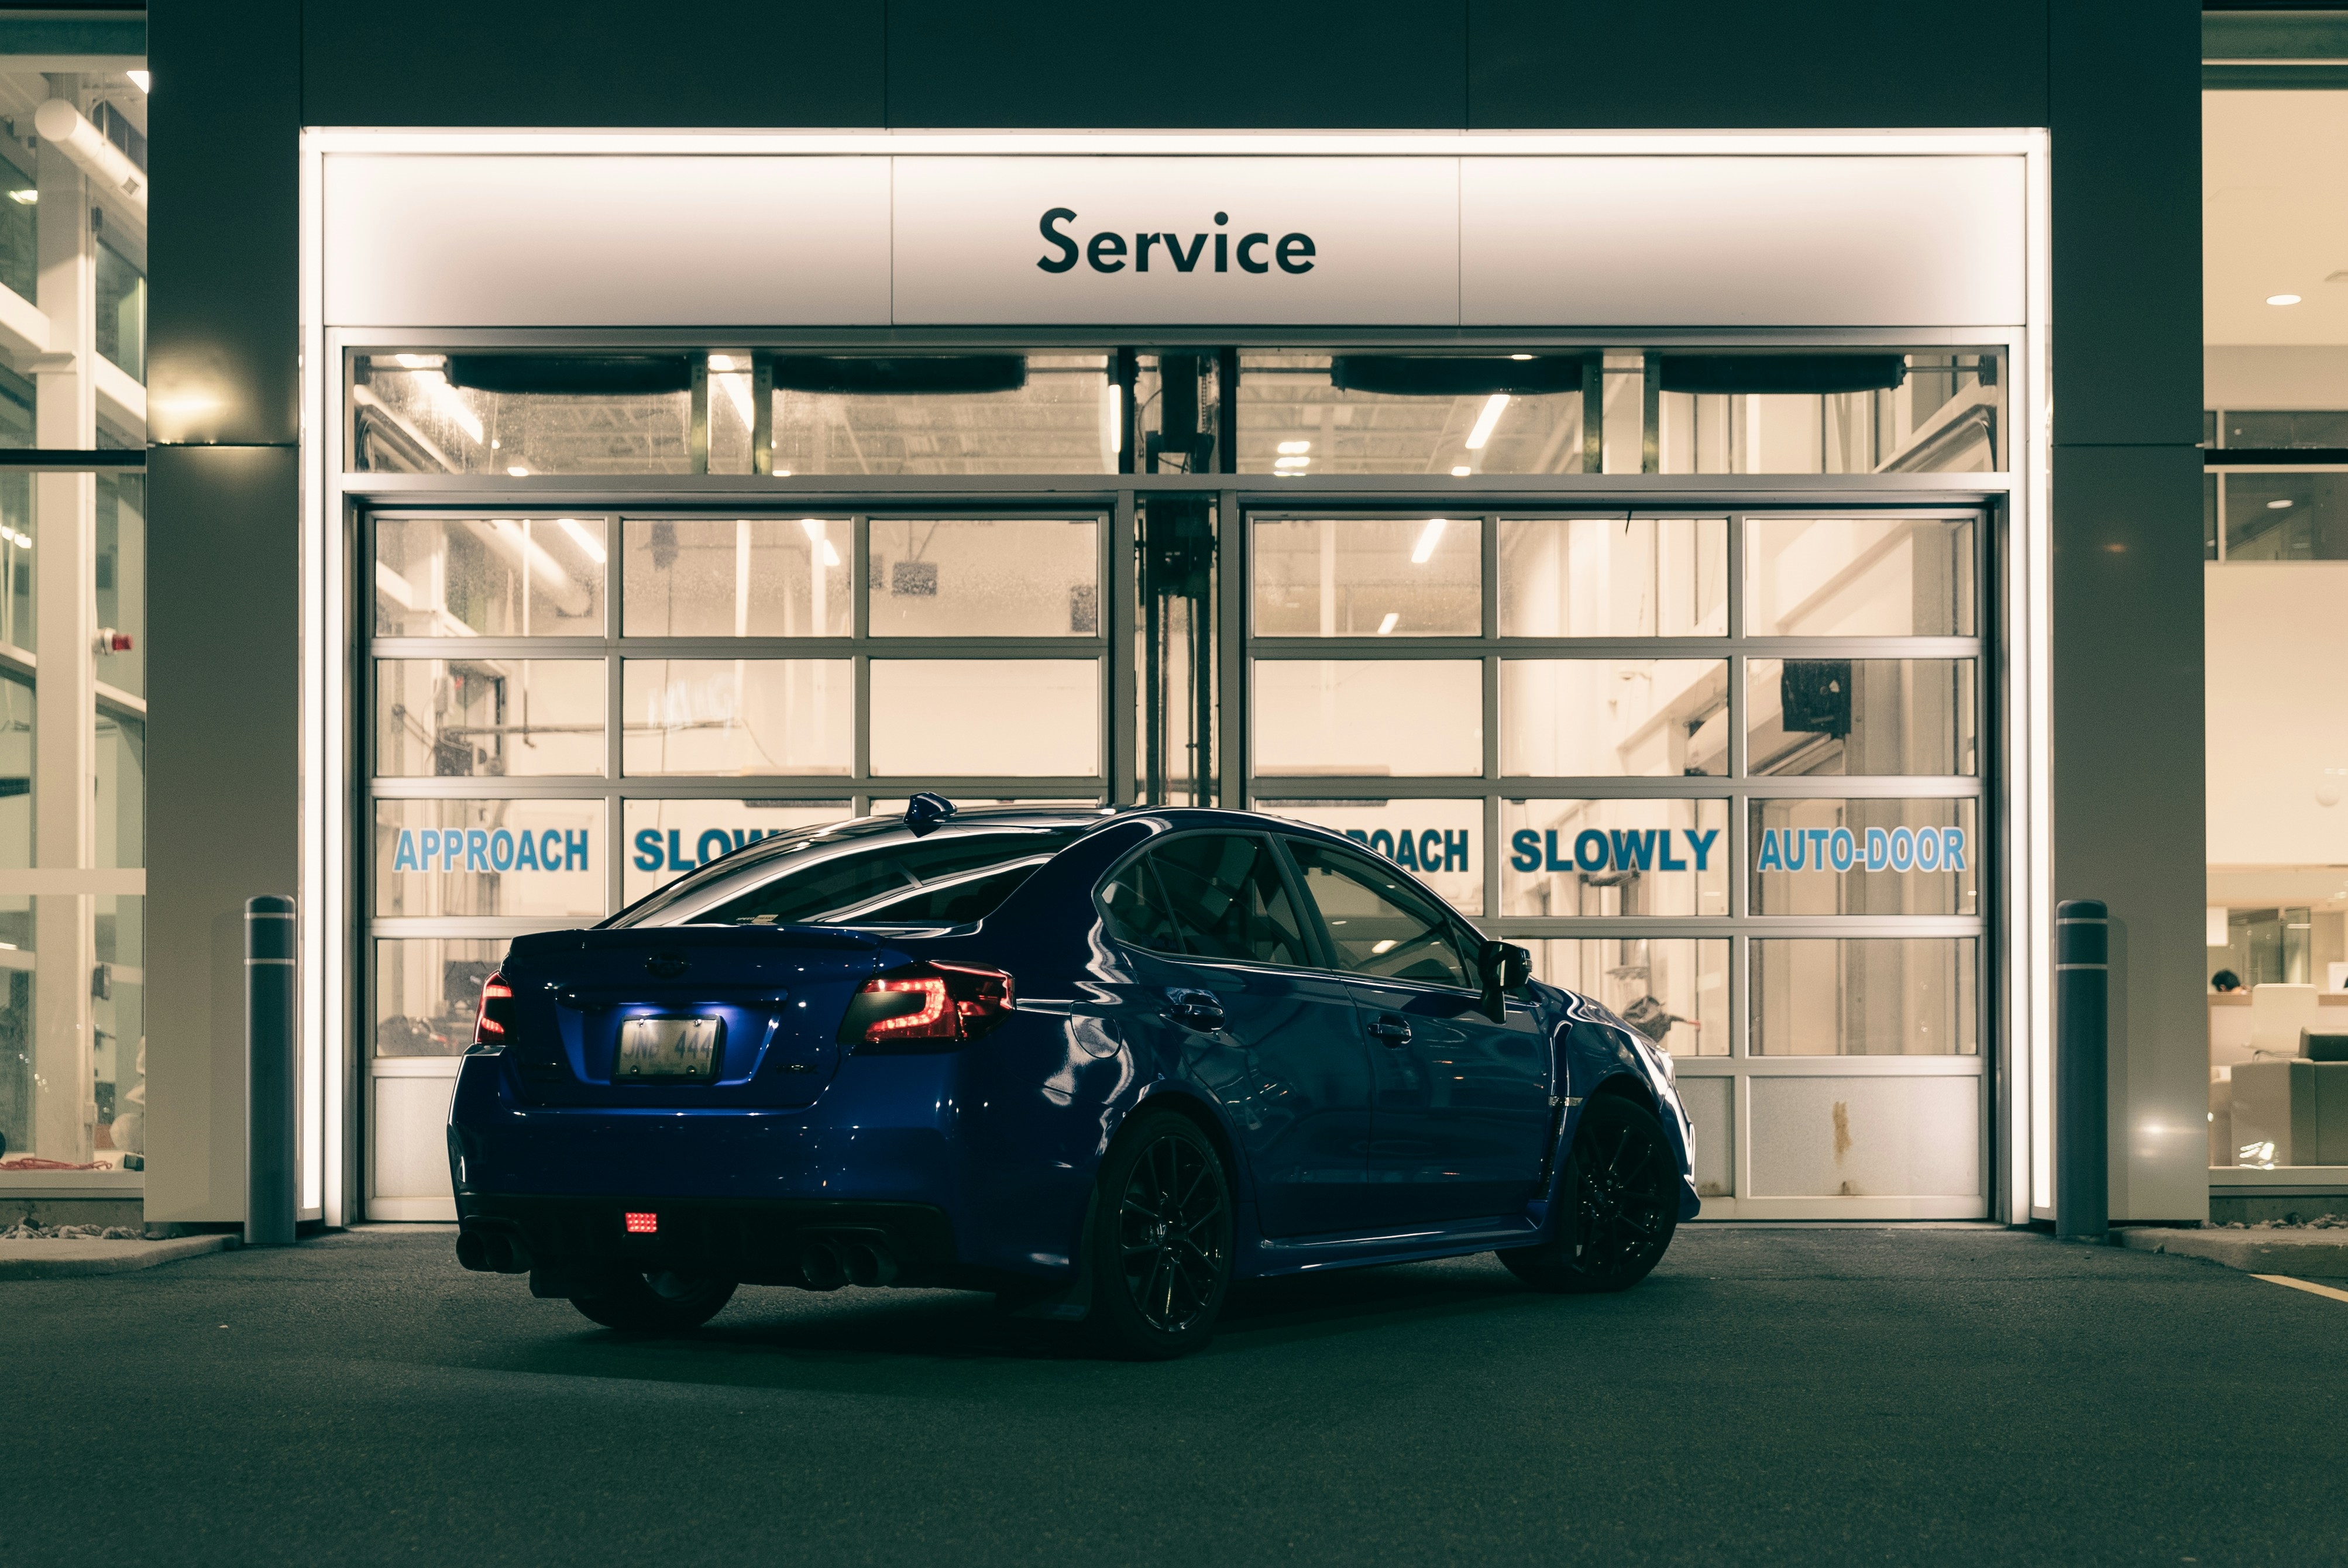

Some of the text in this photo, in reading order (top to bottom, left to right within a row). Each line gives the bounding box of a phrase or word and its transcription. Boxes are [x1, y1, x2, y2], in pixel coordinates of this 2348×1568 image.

[1036, 207, 1316, 274] Service
[393, 828, 788, 872] APPROACH SLO
[1332, 827, 1965, 872] OACH SLOWLY AUTO-DOOR
[675, 1030, 712, 1059] 444
